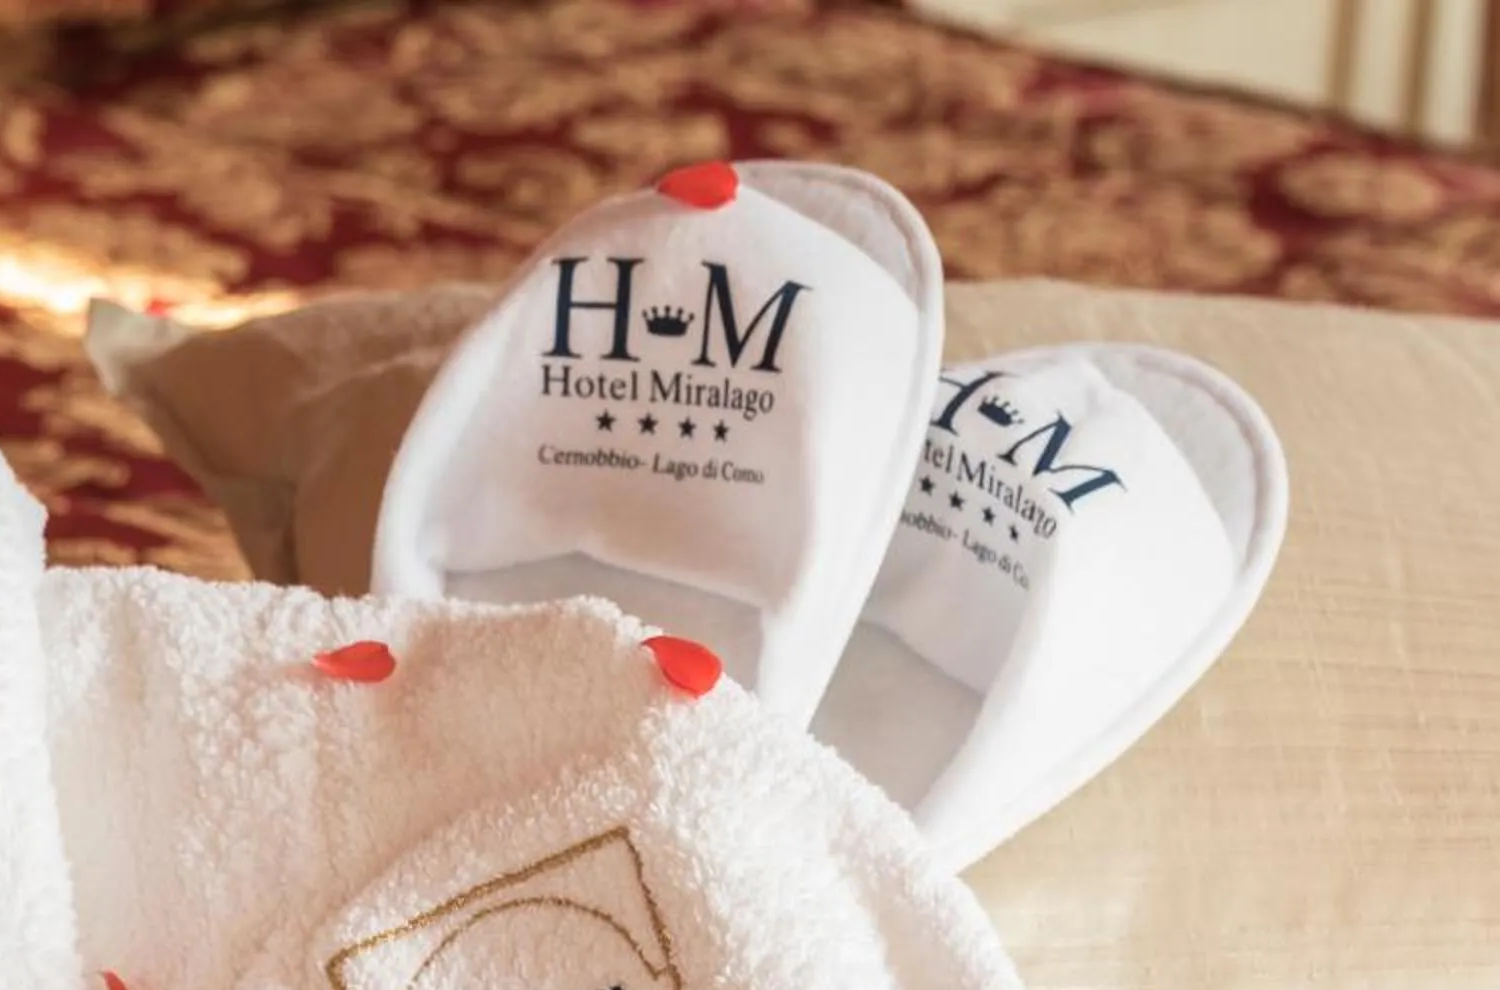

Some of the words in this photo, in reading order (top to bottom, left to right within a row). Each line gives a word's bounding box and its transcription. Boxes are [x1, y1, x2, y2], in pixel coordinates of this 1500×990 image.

[541, 364, 640, 401] Hotel
[649, 368, 776, 422] Miralago
[652, 452, 699, 482] Lago
[702, 453, 718, 480] di
[721, 460, 766, 485] Como
[922, 438, 956, 474] tel
